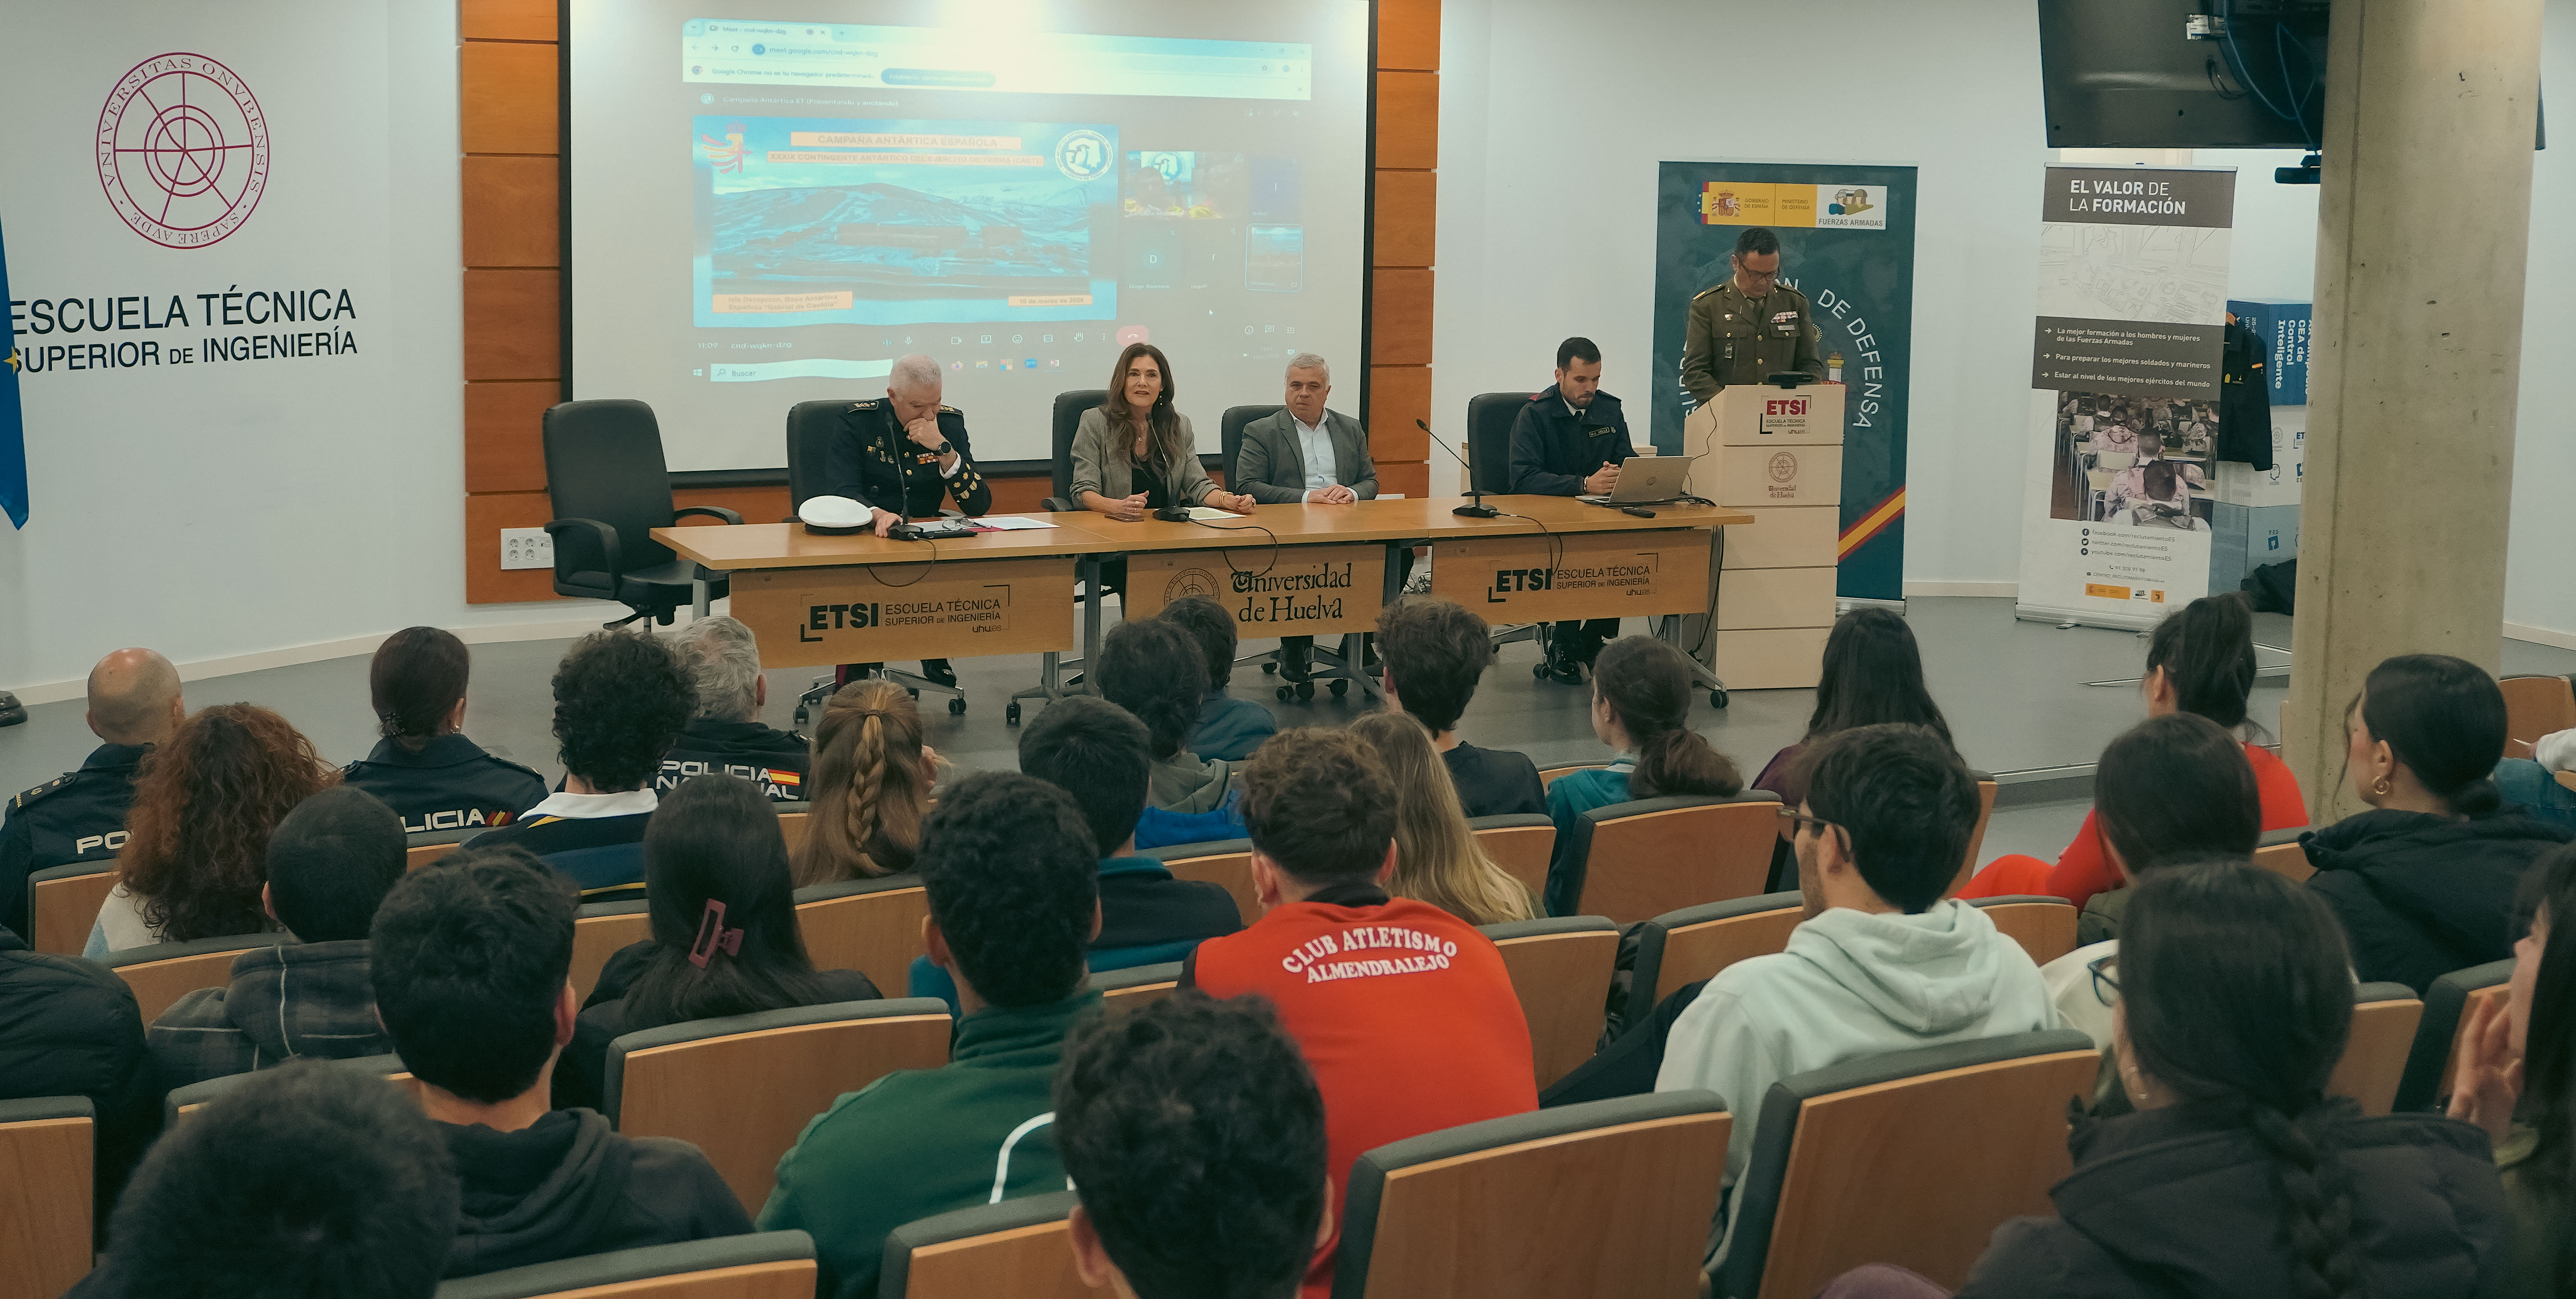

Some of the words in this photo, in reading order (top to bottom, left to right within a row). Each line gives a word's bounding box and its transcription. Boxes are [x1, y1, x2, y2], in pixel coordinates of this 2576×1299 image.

[723, 96, 758, 104] Campaña
[102, 58, 192, 187] VNIVERSITAS
[202, 62, 265, 193] ONVBENSIS
[818, 134, 873, 145] CAMPAÑA
[876, 135, 938, 146] ANTÁRTICA
[941, 136, 997, 148] ESPAÑOLA
[2070, 180, 2090, 193] EL
[2094, 181, 2143, 195] VALOR
[2148, 182, 2169, 195] DE
[2069, 198, 2088, 212] LA
[2092, 196, 2186, 214] FORMACIÓN
[131, 212, 173, 242] AVDE
[178, 212, 239, 244] SAPERE
[1149, 254, 1157, 264] D
[10, 294, 189, 335] ESCUELA
[197, 285, 356, 327] TÉCNICA
[2087, 329, 2119, 337] formación
[2137, 332, 2166, 340] hombres
[2286, 319, 2296, 365] Control
[2297, 319, 2306, 344] CEA
[170, 349, 193, 365] DE
[203, 326, 358, 363] INGENIERÍA
[2274, 319, 2286, 389] Inteligente
[2297, 346, 2304, 362] de
[1818, 289, 1851, 320] DE
[1846, 317, 1883, 428] DEFENSA
[2140, 359, 2170, 367] soldados
[2118, 376, 2144, 384] mejores
[2145, 377, 2174, 385] ejércitos
[1767, 399, 1807, 415] ETSI
[1230, 562, 1351, 593] Universidad
[1496, 568, 1552, 593] ETSI
[1558, 567, 1604, 579] ESCUELA
[1607, 564, 1650, 577] TÉCNICA
[1557, 580, 1596, 590] SUPERIOR
[1606, 576, 1650, 587] INGENIERÍA
[1626, 588, 1650, 596] uhu.es
[810, 602, 878, 630] ETSI
[885, 602, 944, 616] ESCUELA
[946, 597, 1000, 612] TÉCNICA
[885, 616, 934, 627] SUPERIOR
[947, 611, 1000, 622] INGENIERÍA
[1239, 596, 1264, 622] de
[1269, 594, 1343, 622] Huelva
[972, 624, 1002, 633] uhu.es
[658, 760, 773, 783] POLICIA
[400, 808, 485, 833] LICIA
[1282, 934, 1338, 973] CLUB
[1342, 926, 1458, 959] ATLETISMO
[1307, 954, 1450, 984] ALMENDRALEJO
